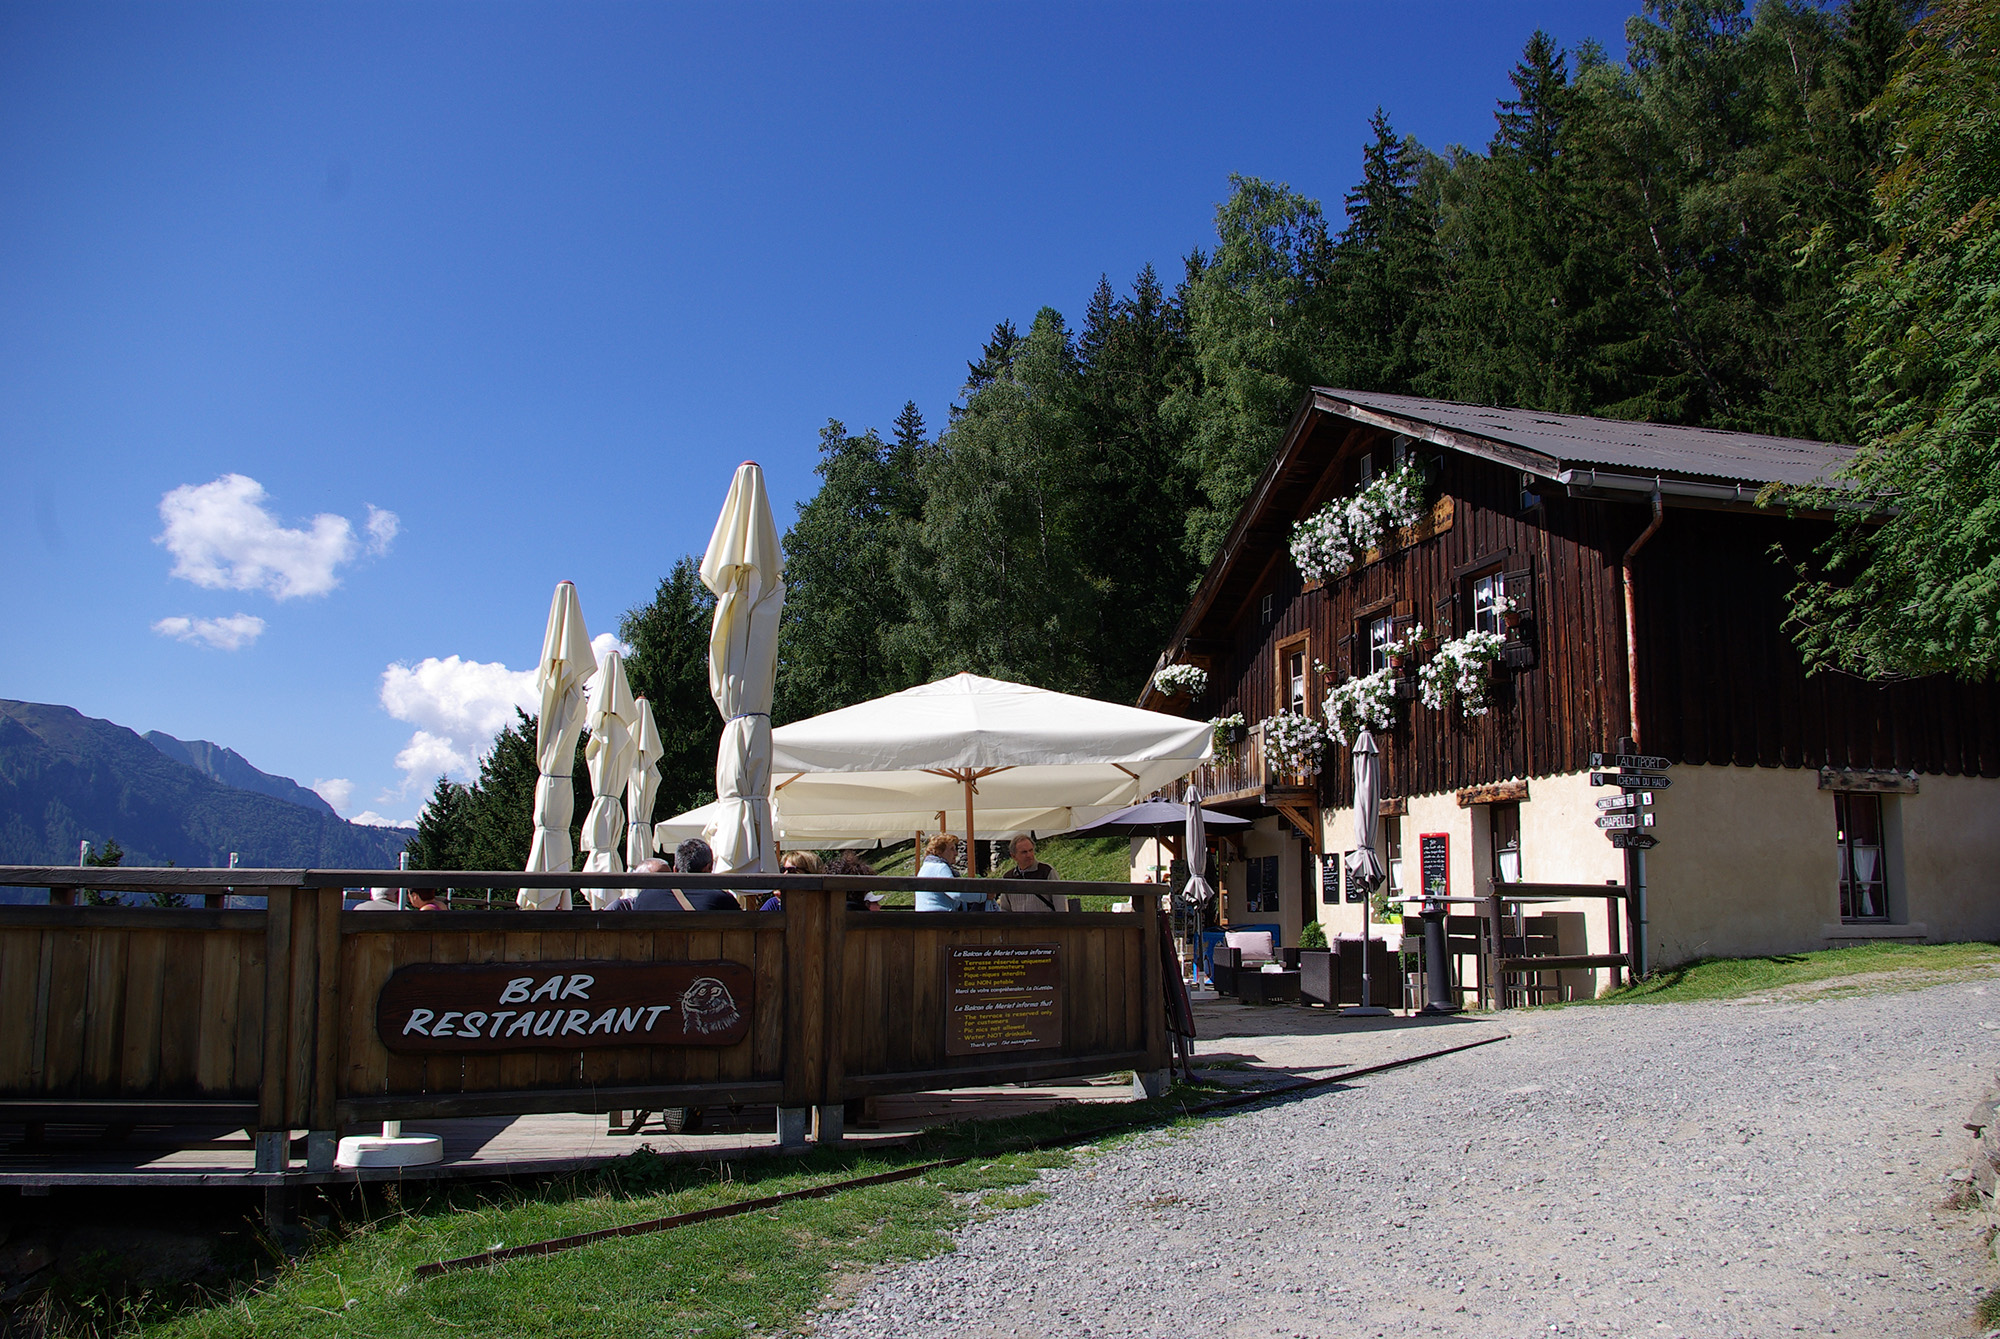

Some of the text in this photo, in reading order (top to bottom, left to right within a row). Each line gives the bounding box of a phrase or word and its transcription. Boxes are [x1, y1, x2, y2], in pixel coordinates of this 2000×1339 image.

[1620, 756, 1660, 768] ALTIPORT
[1619, 776, 1667, 787] CHEMIN DU HAUT
[1600, 815, 1632, 827] CHAPELLE
[1626, 835, 1638, 846] WC
[953, 950, 962, 958] Le
[983, 949, 992, 957] de
[498, 974, 596, 1006] BAR
[401, 1005, 672, 1039] RESTAURANT
[977, 1018, 1009, 1026] customers
[1004, 1030, 1032, 1038] drinkable
